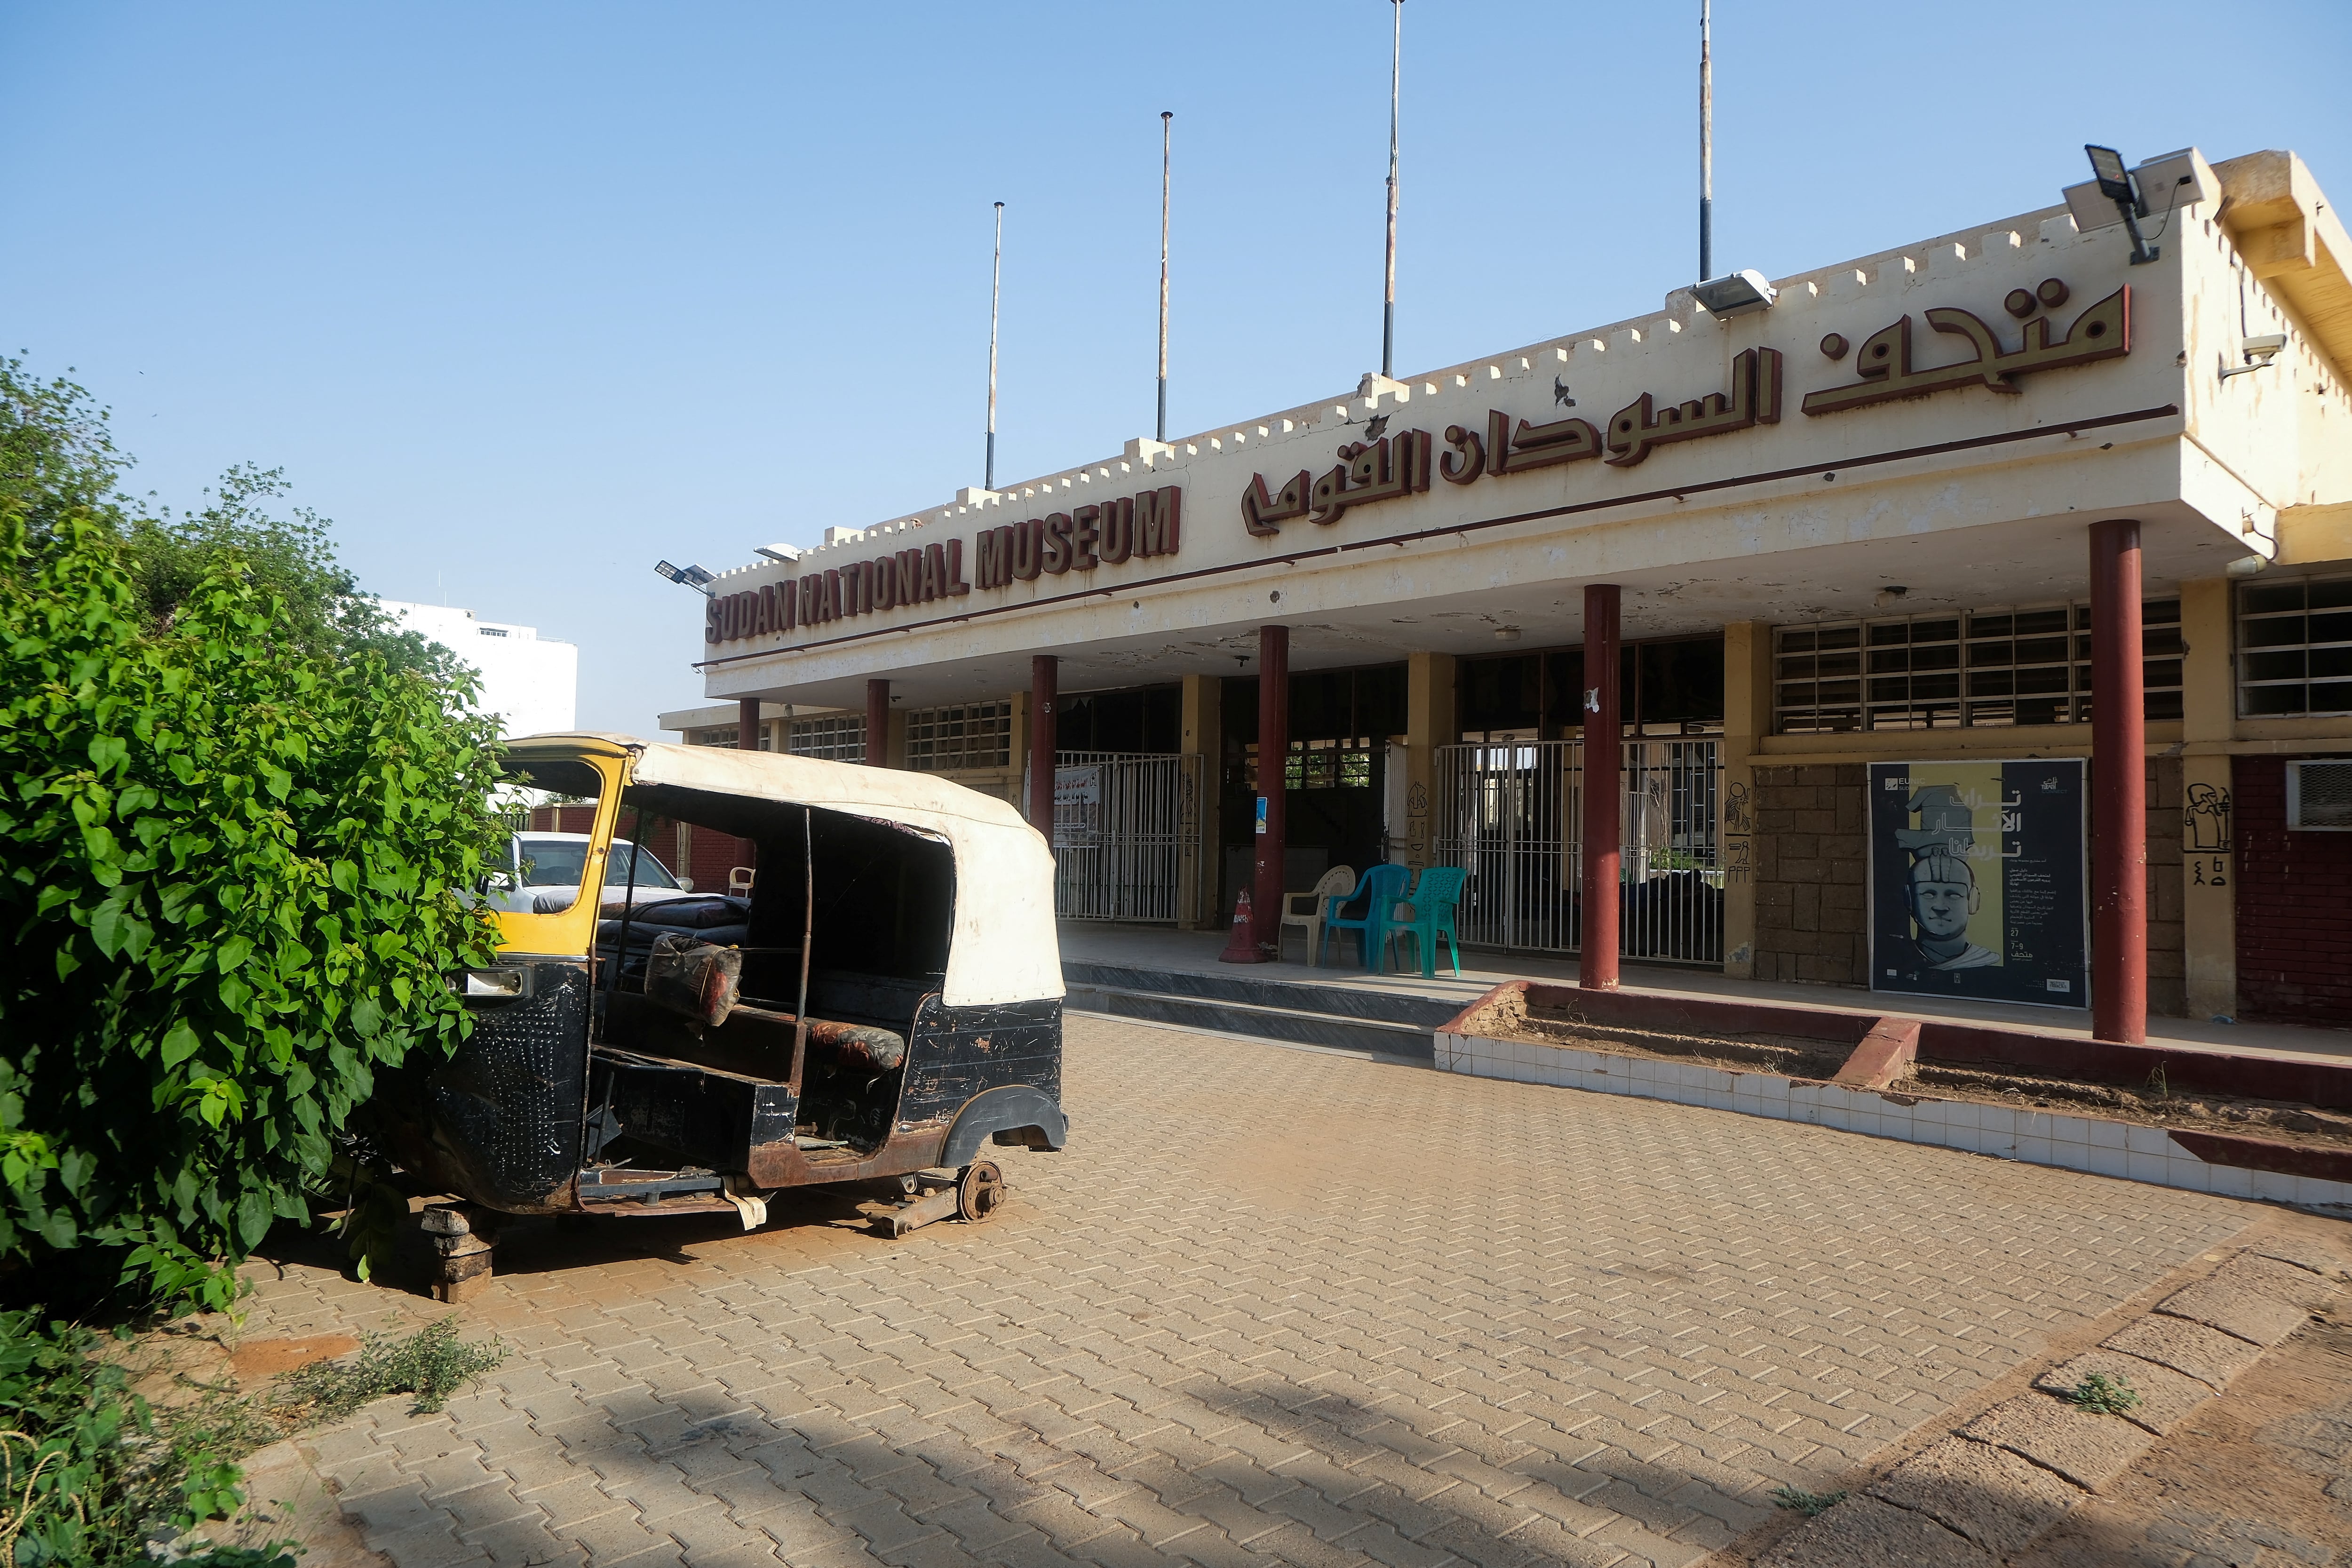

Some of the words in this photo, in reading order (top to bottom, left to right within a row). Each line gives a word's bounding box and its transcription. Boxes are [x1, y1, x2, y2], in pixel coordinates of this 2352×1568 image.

[1801, 278, 2130, 416] متحف
[1439, 346, 1782, 485] السودان
[706, 580, 796, 644] SUDAN
[798, 538, 969, 626] NATIONAL
[975, 485, 1181, 589] MUSEUM
[1931, 809, 2021, 835] الآثار
[1949, 788, 2021, 811] تراث
[1949, 837, 2022, 861] تربطنا
